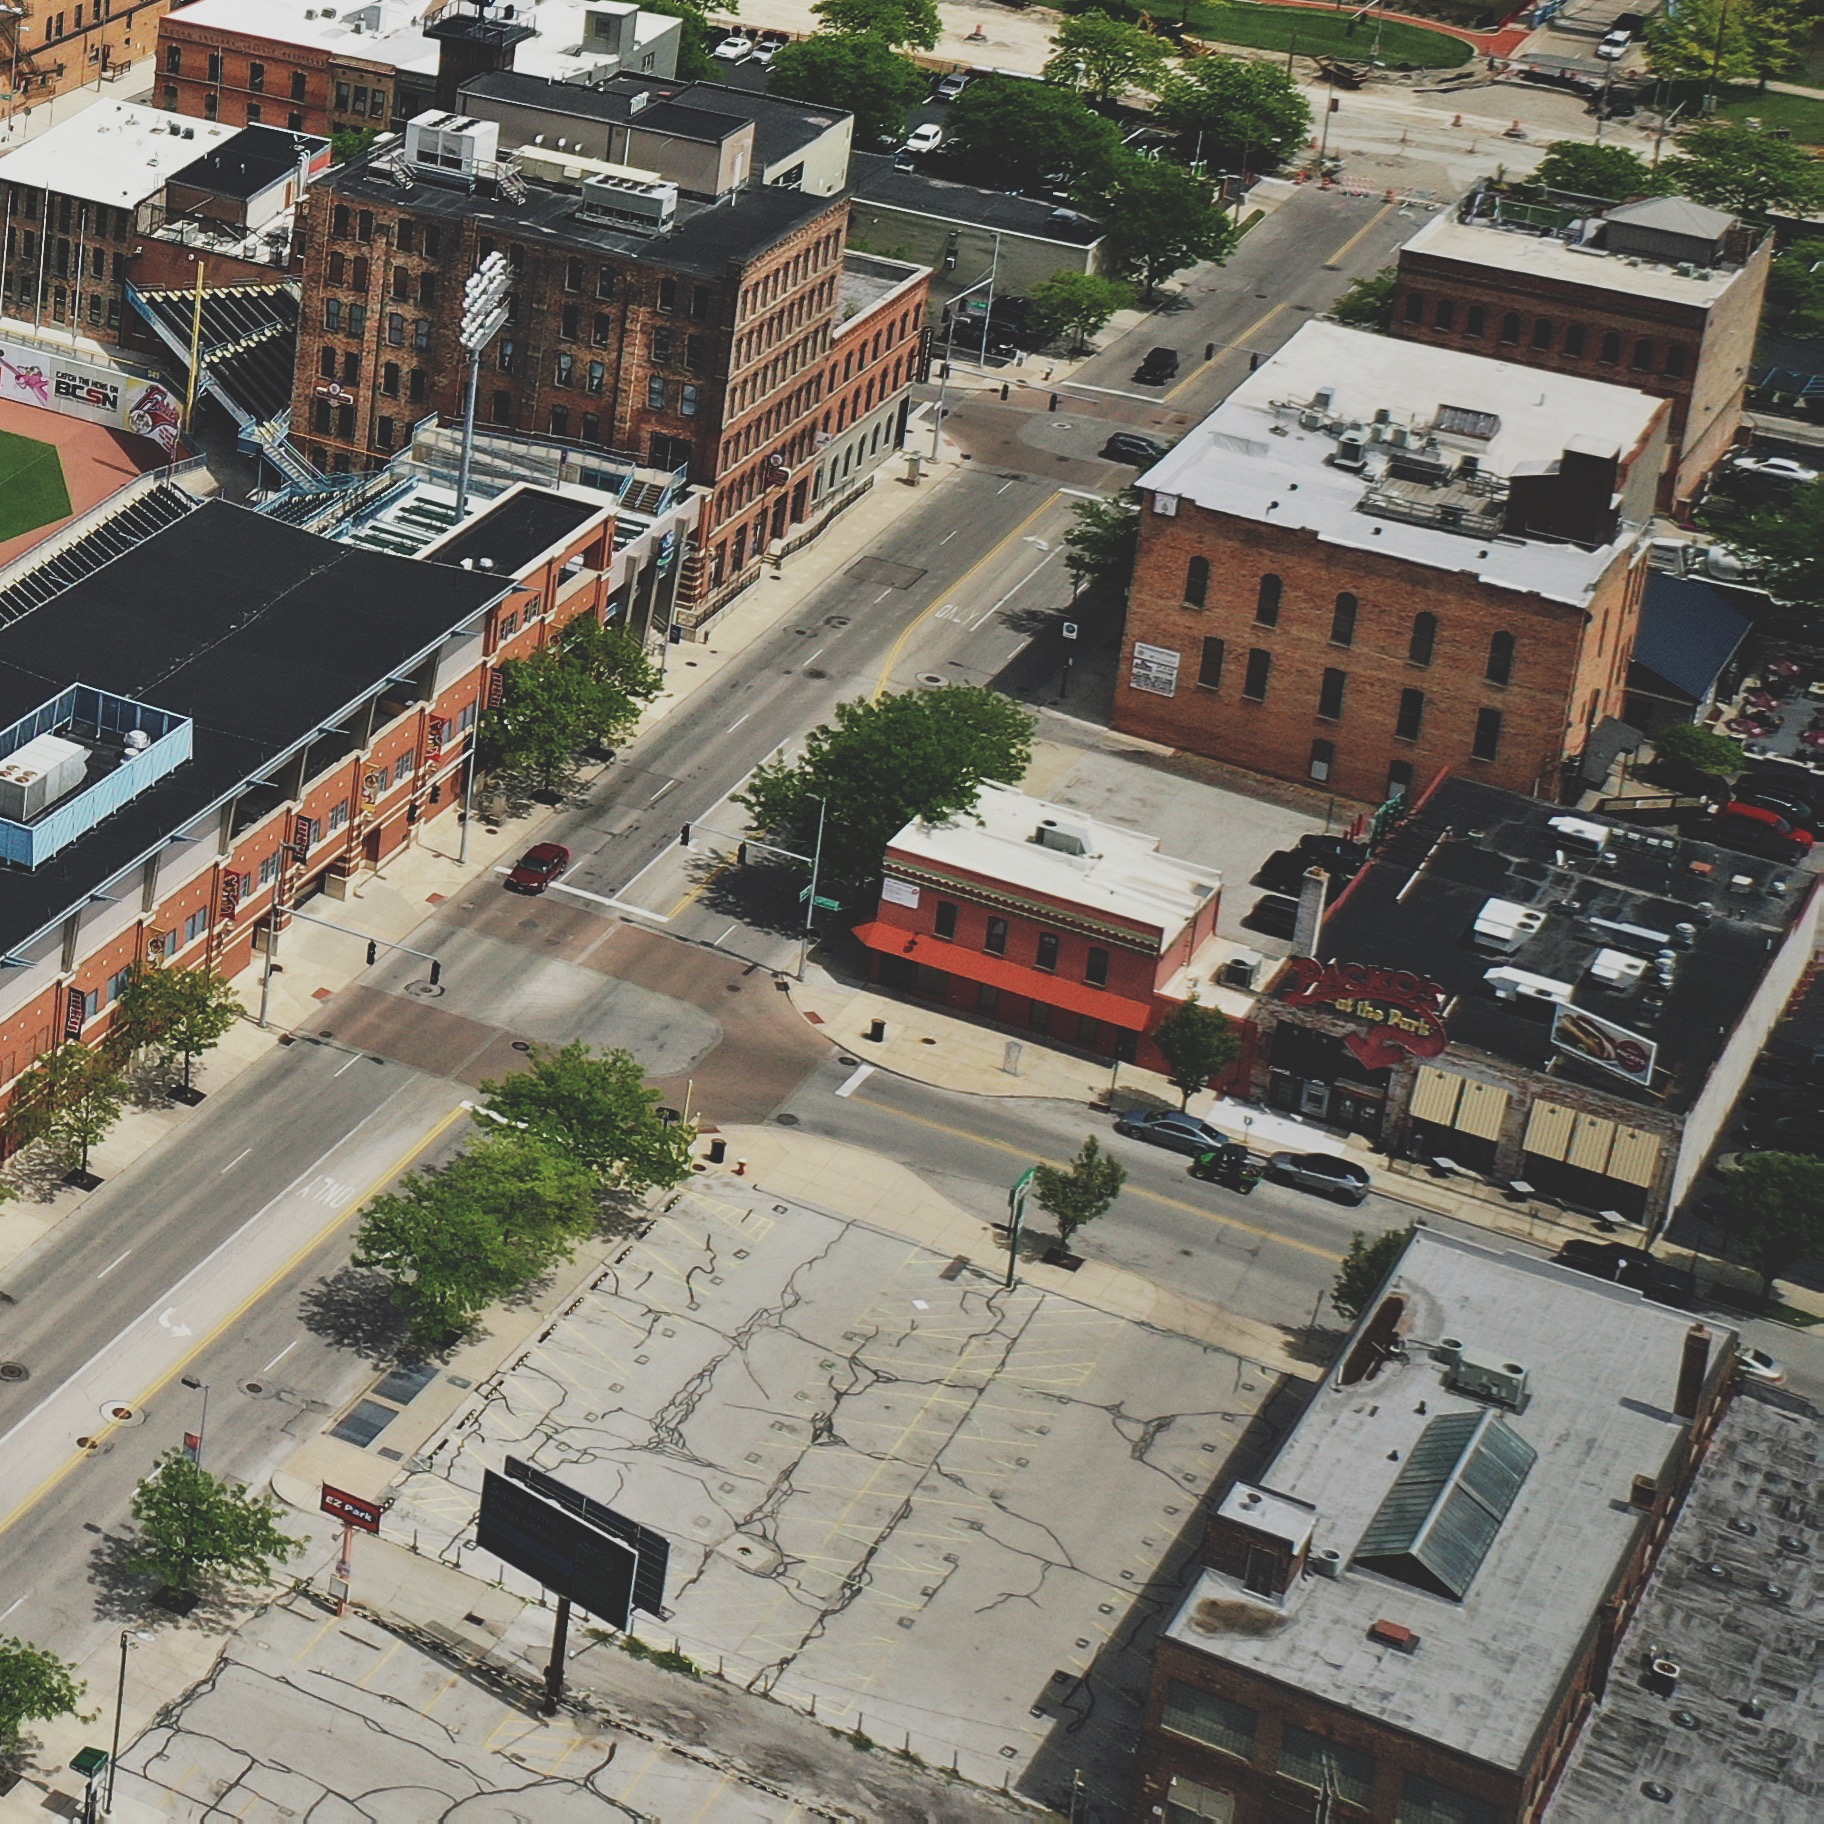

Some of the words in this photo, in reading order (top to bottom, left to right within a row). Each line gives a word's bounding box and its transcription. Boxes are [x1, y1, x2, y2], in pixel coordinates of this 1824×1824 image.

[56, 371, 77, 383] CATCH
[78, 376, 90, 386] THE
[54, 379, 118, 409] BCSN
[935, 604, 979, 625] ONLY
[1333, 997, 1353, 1013] at
[1355, 999, 1384, 1023] the
[1388, 1009, 1434, 1037] Park
[296, 1175, 356, 1209] ONLY
[324, 1495, 342, 1509] EZ
[344, 1502, 373, 1523] Park
